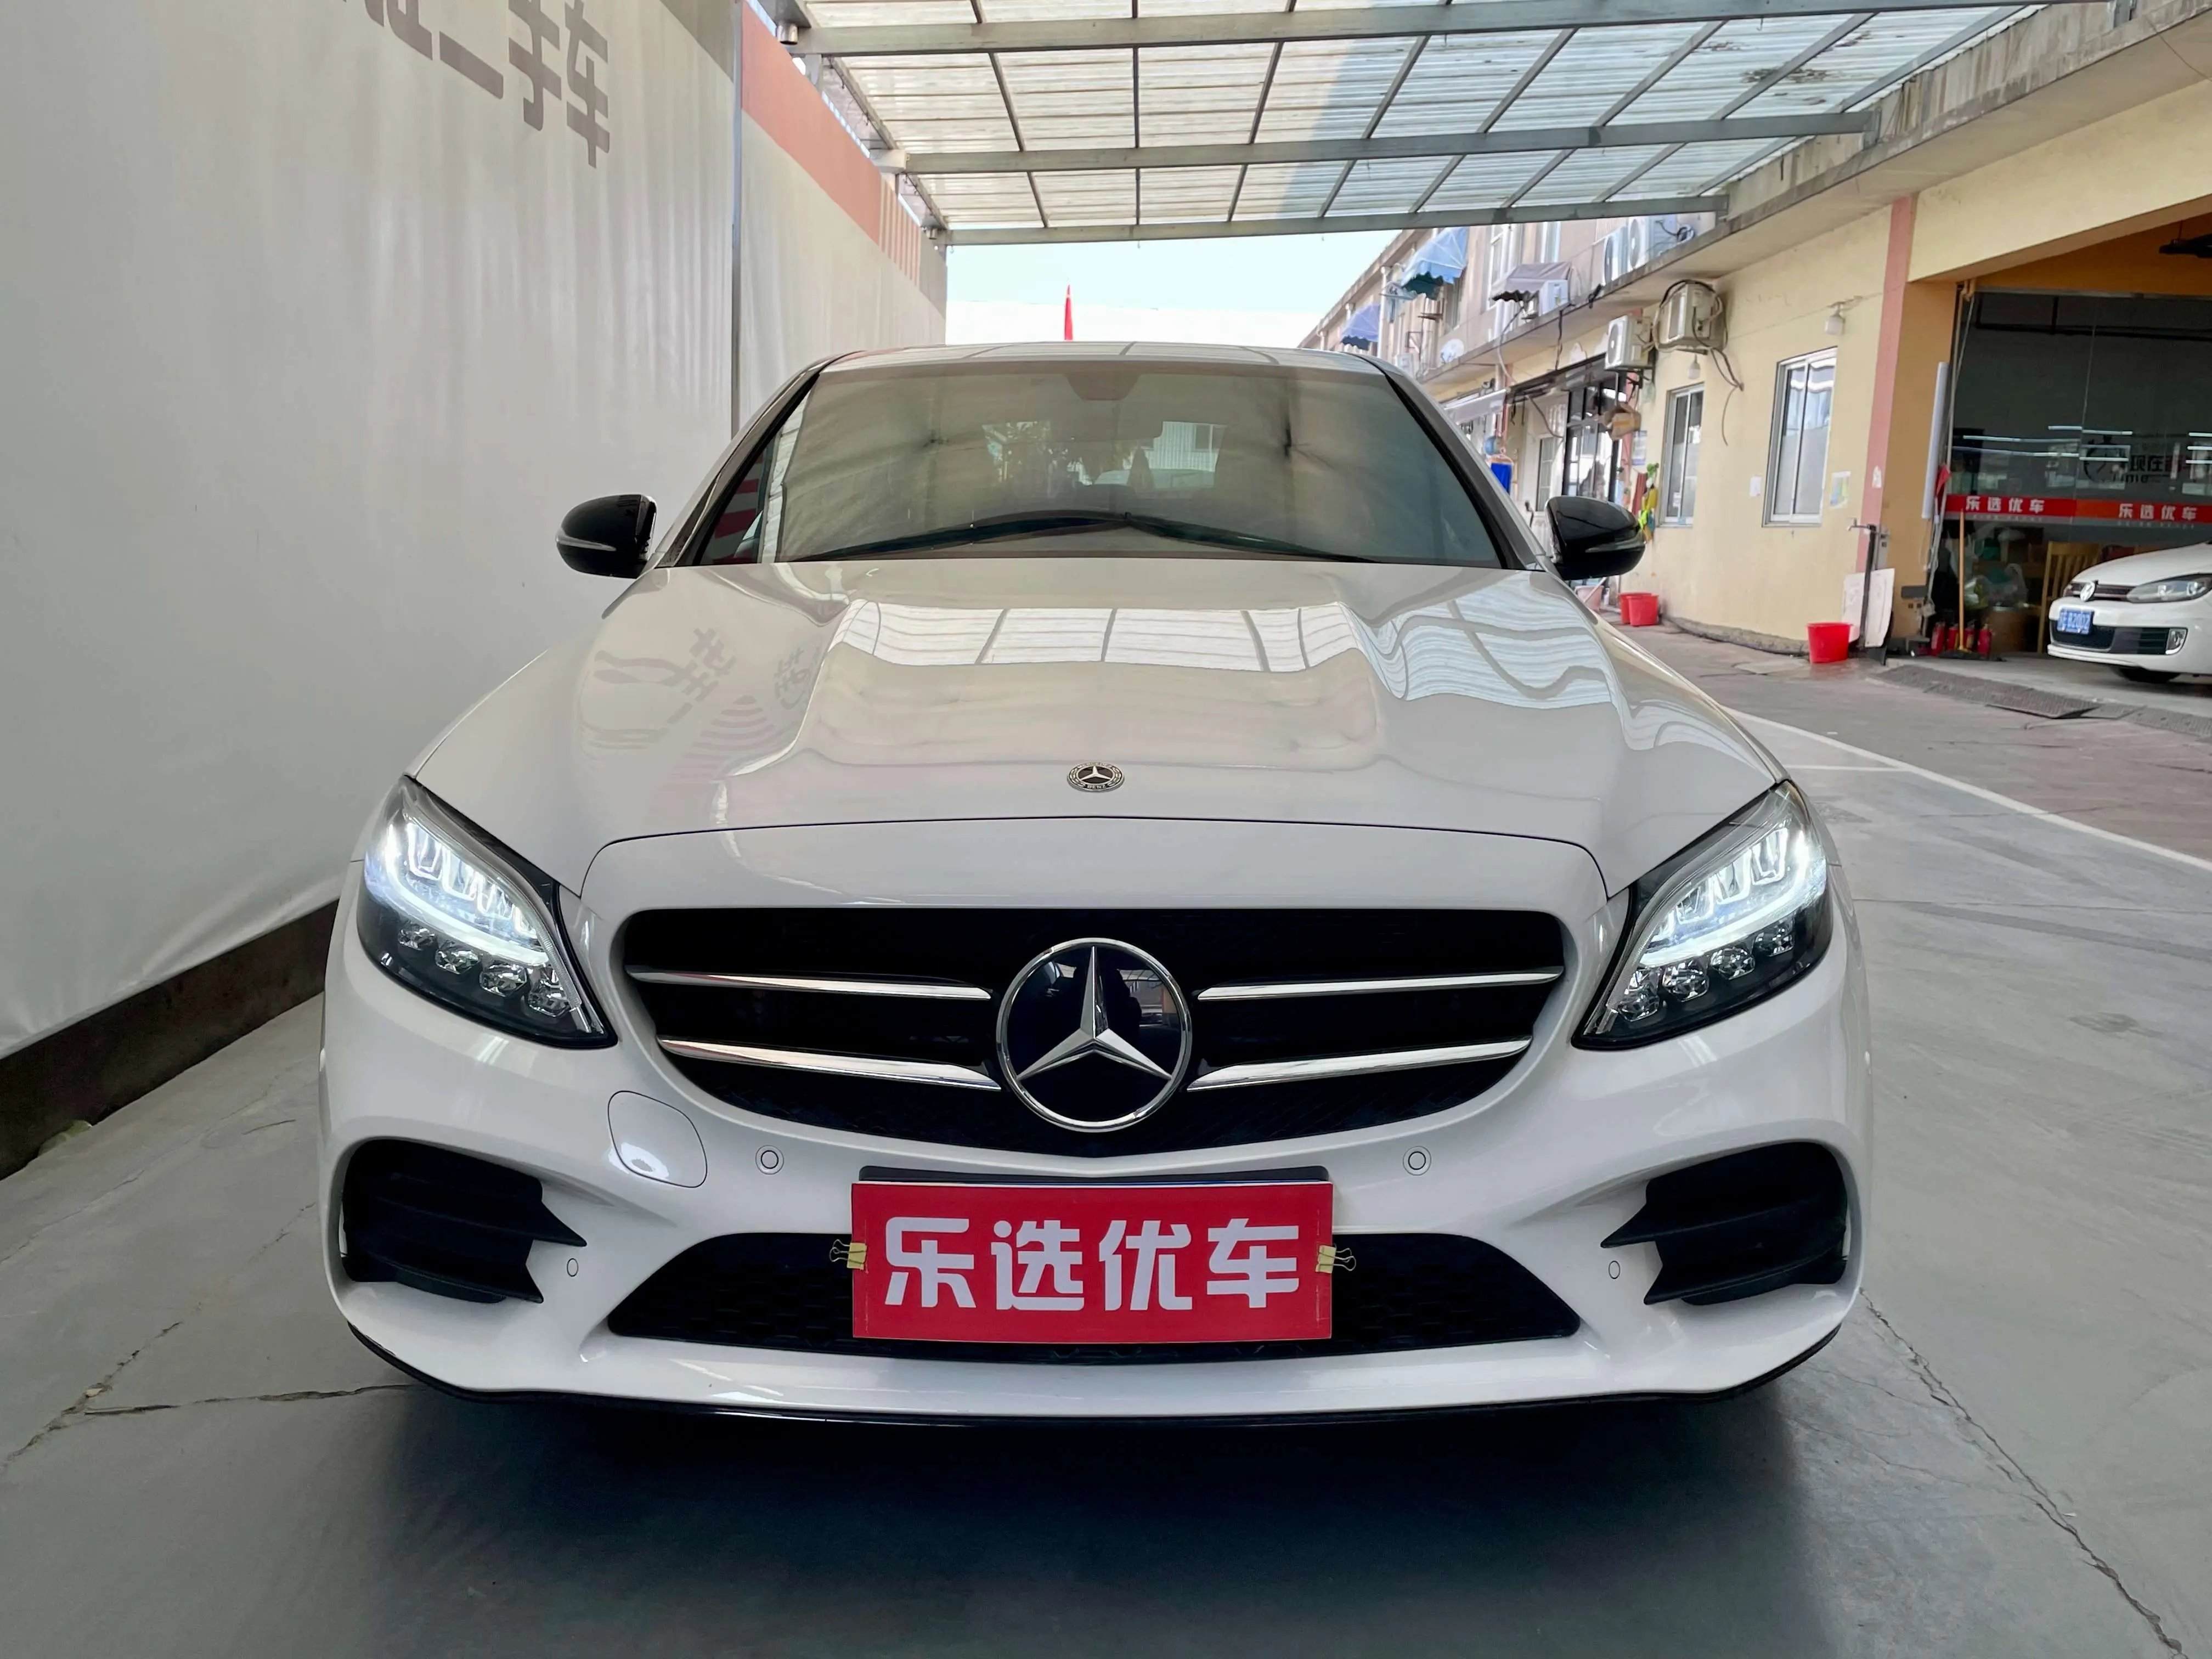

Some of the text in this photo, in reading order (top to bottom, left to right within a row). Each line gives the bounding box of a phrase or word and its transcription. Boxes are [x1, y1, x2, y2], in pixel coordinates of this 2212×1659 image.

[1966, 495, 2045, 514] 乐选优车
[2118, 503, 2197, 521] 乐选优车
[884, 1216, 1300, 1311] 乐选优车
